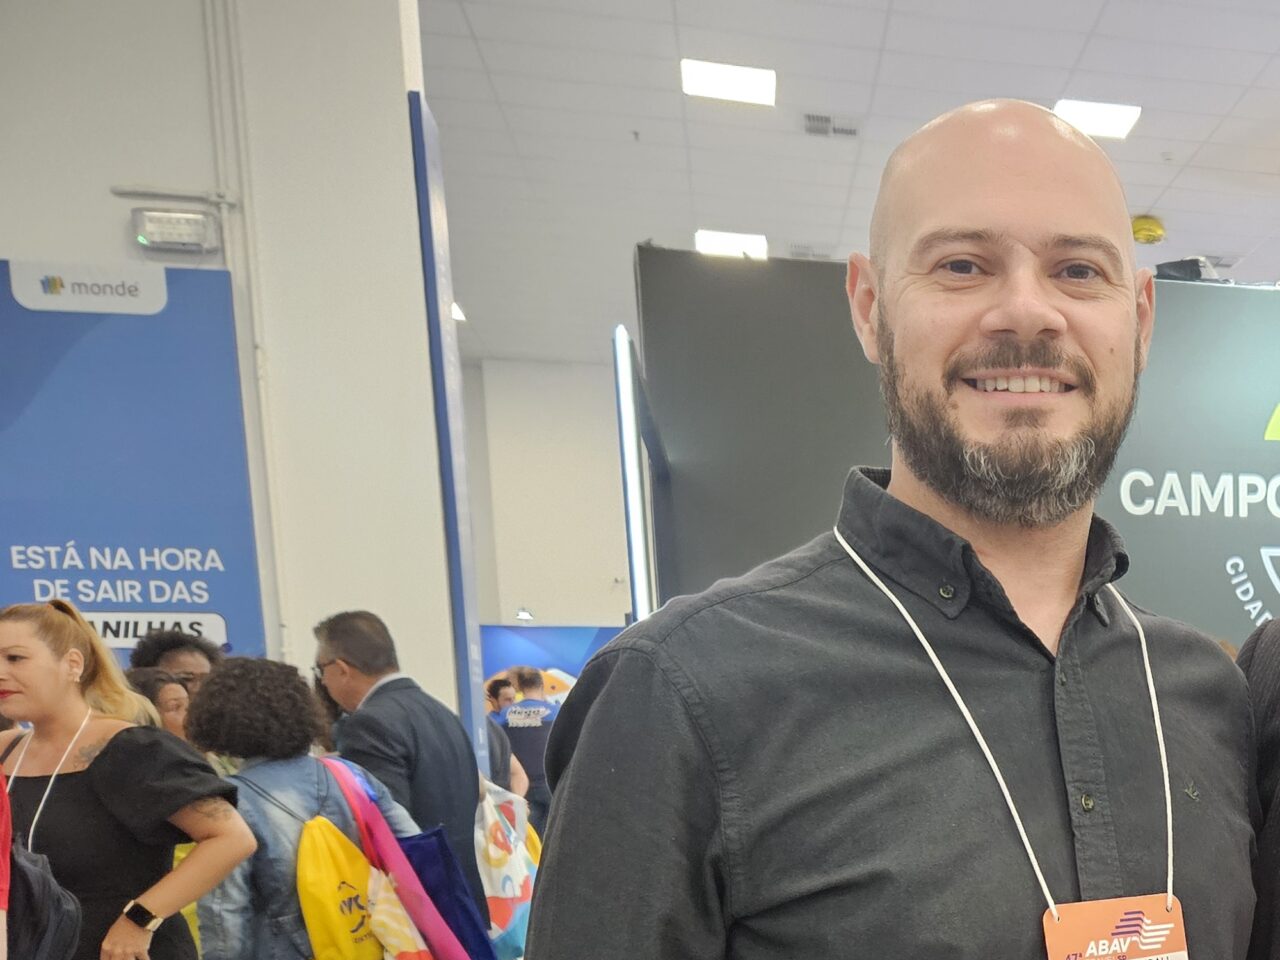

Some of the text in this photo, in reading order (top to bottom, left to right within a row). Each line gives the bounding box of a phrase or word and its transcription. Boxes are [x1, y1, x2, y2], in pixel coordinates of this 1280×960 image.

[71, 281, 139, 298] monde
[10, 540, 225, 572] ESTÁ NA HORA
[33, 578, 209, 604] DE SAIR DAS
[1085, 936, 1132, 957] ABAV
